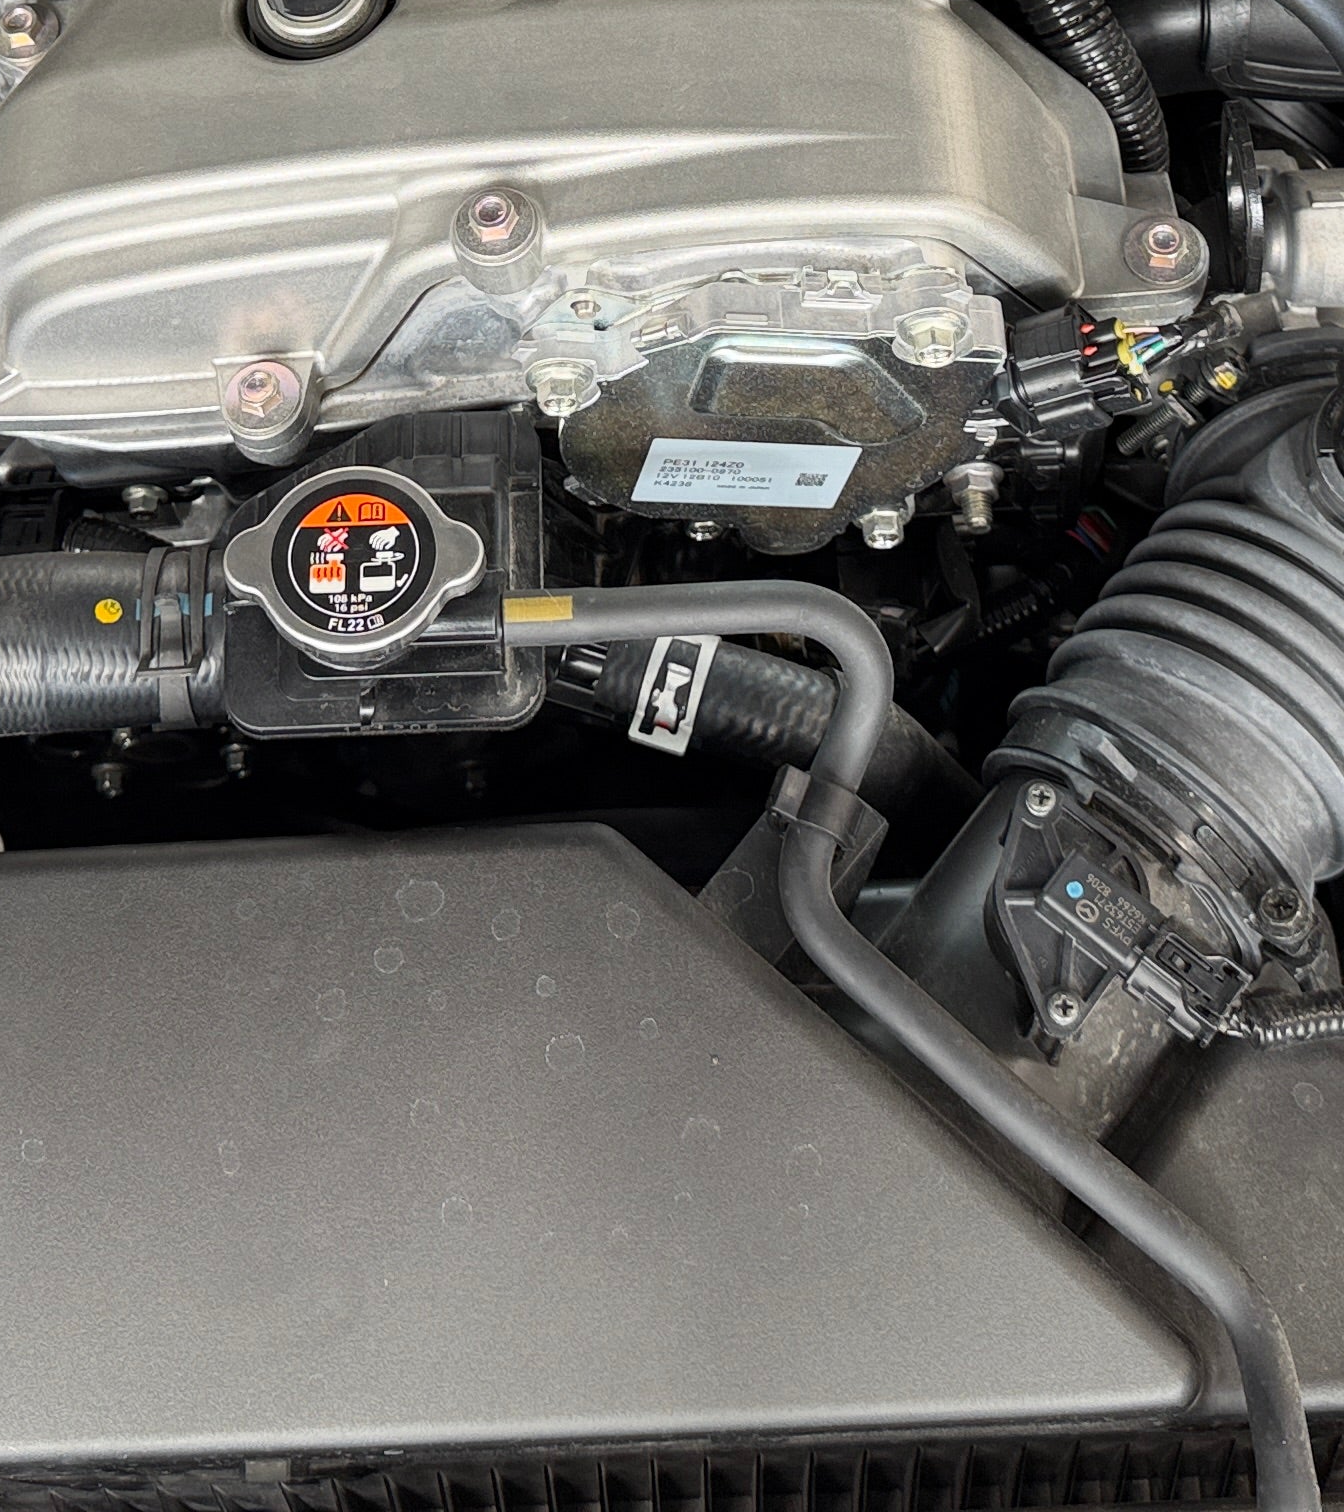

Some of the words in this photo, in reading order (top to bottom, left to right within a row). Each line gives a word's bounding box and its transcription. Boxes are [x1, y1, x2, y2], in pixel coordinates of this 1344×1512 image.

[662, 458, 697, 466] PE31
[328, 594, 348, 603] 108
[350, 594, 372, 602] kPa
[334, 603, 348, 612] 16
[350, 604, 368, 613] psi
[328, 618, 364, 630] FL22
[1100, 915, 1135, 946] PYFS
